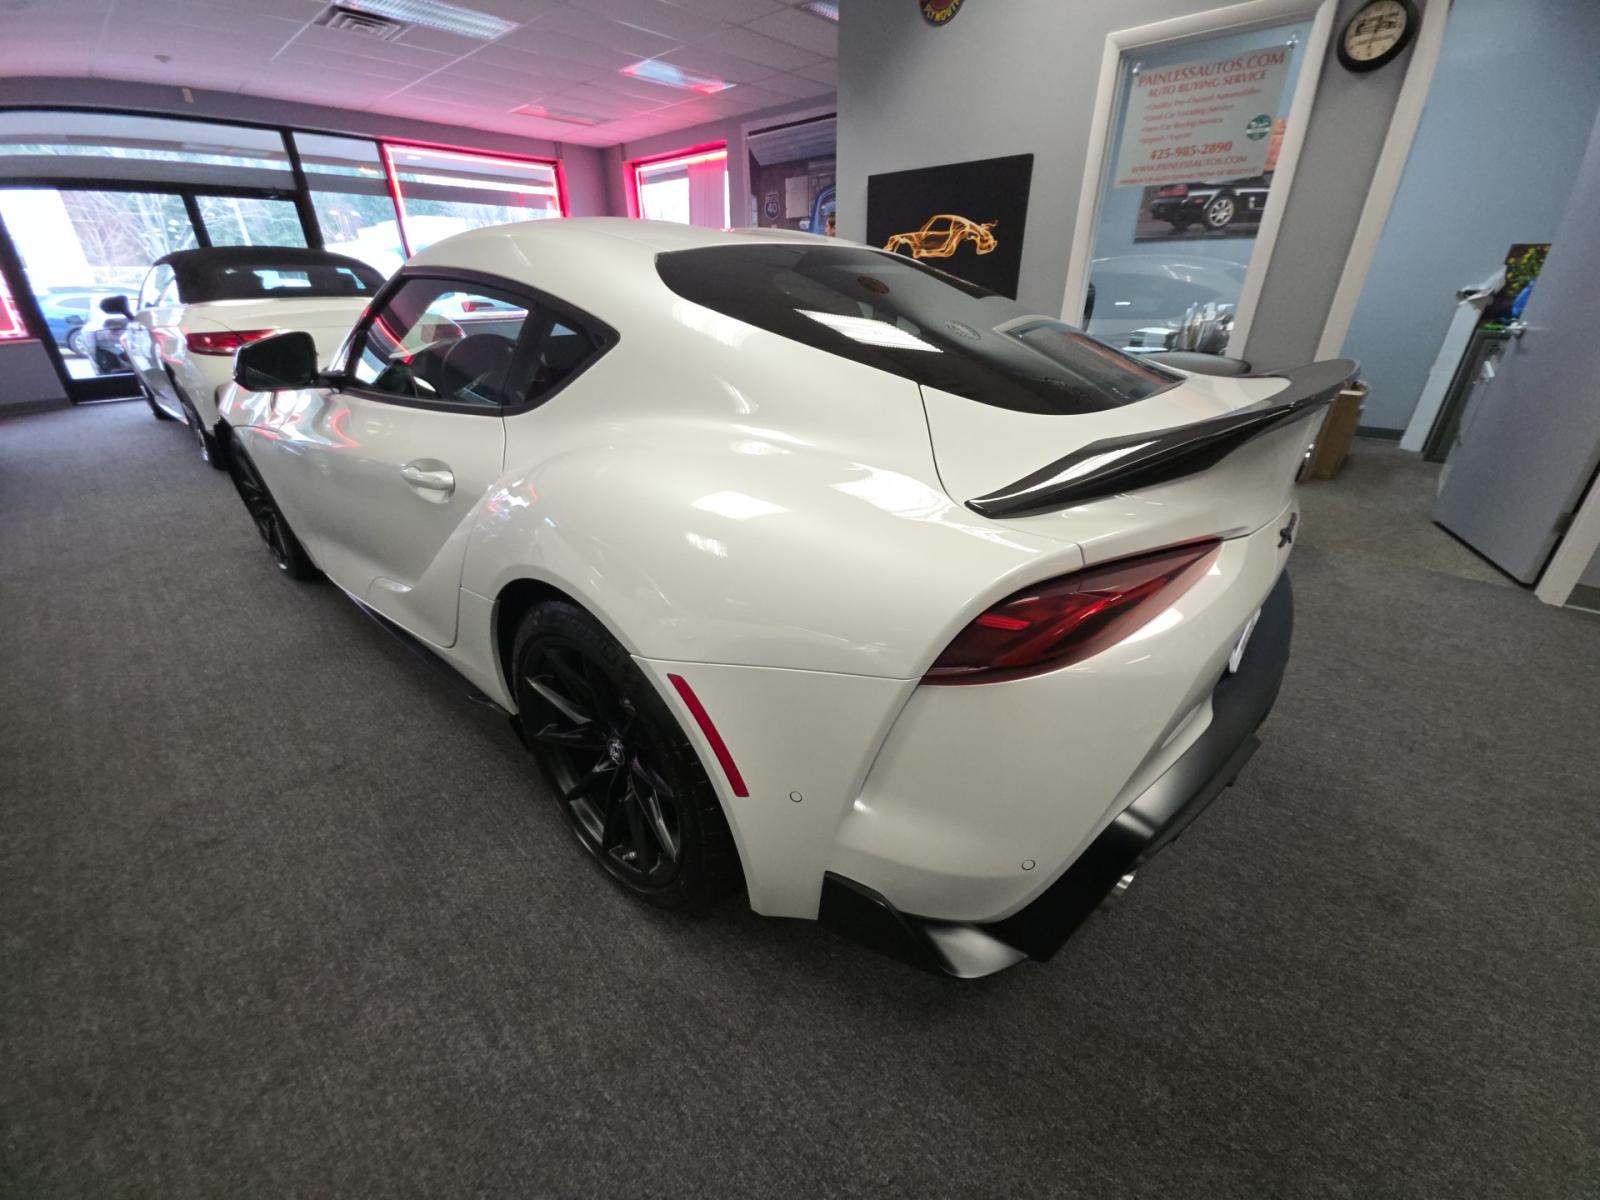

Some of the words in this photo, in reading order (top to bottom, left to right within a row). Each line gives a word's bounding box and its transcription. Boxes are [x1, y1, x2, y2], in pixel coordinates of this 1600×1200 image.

[1138, 52, 1285, 87] PAINLESSAUTOS.COM
[1147, 85, 1176, 97] AUTO
[1178, 80, 1218, 93] BUYING
[1223, 69, 1268, 84] SERVICE
